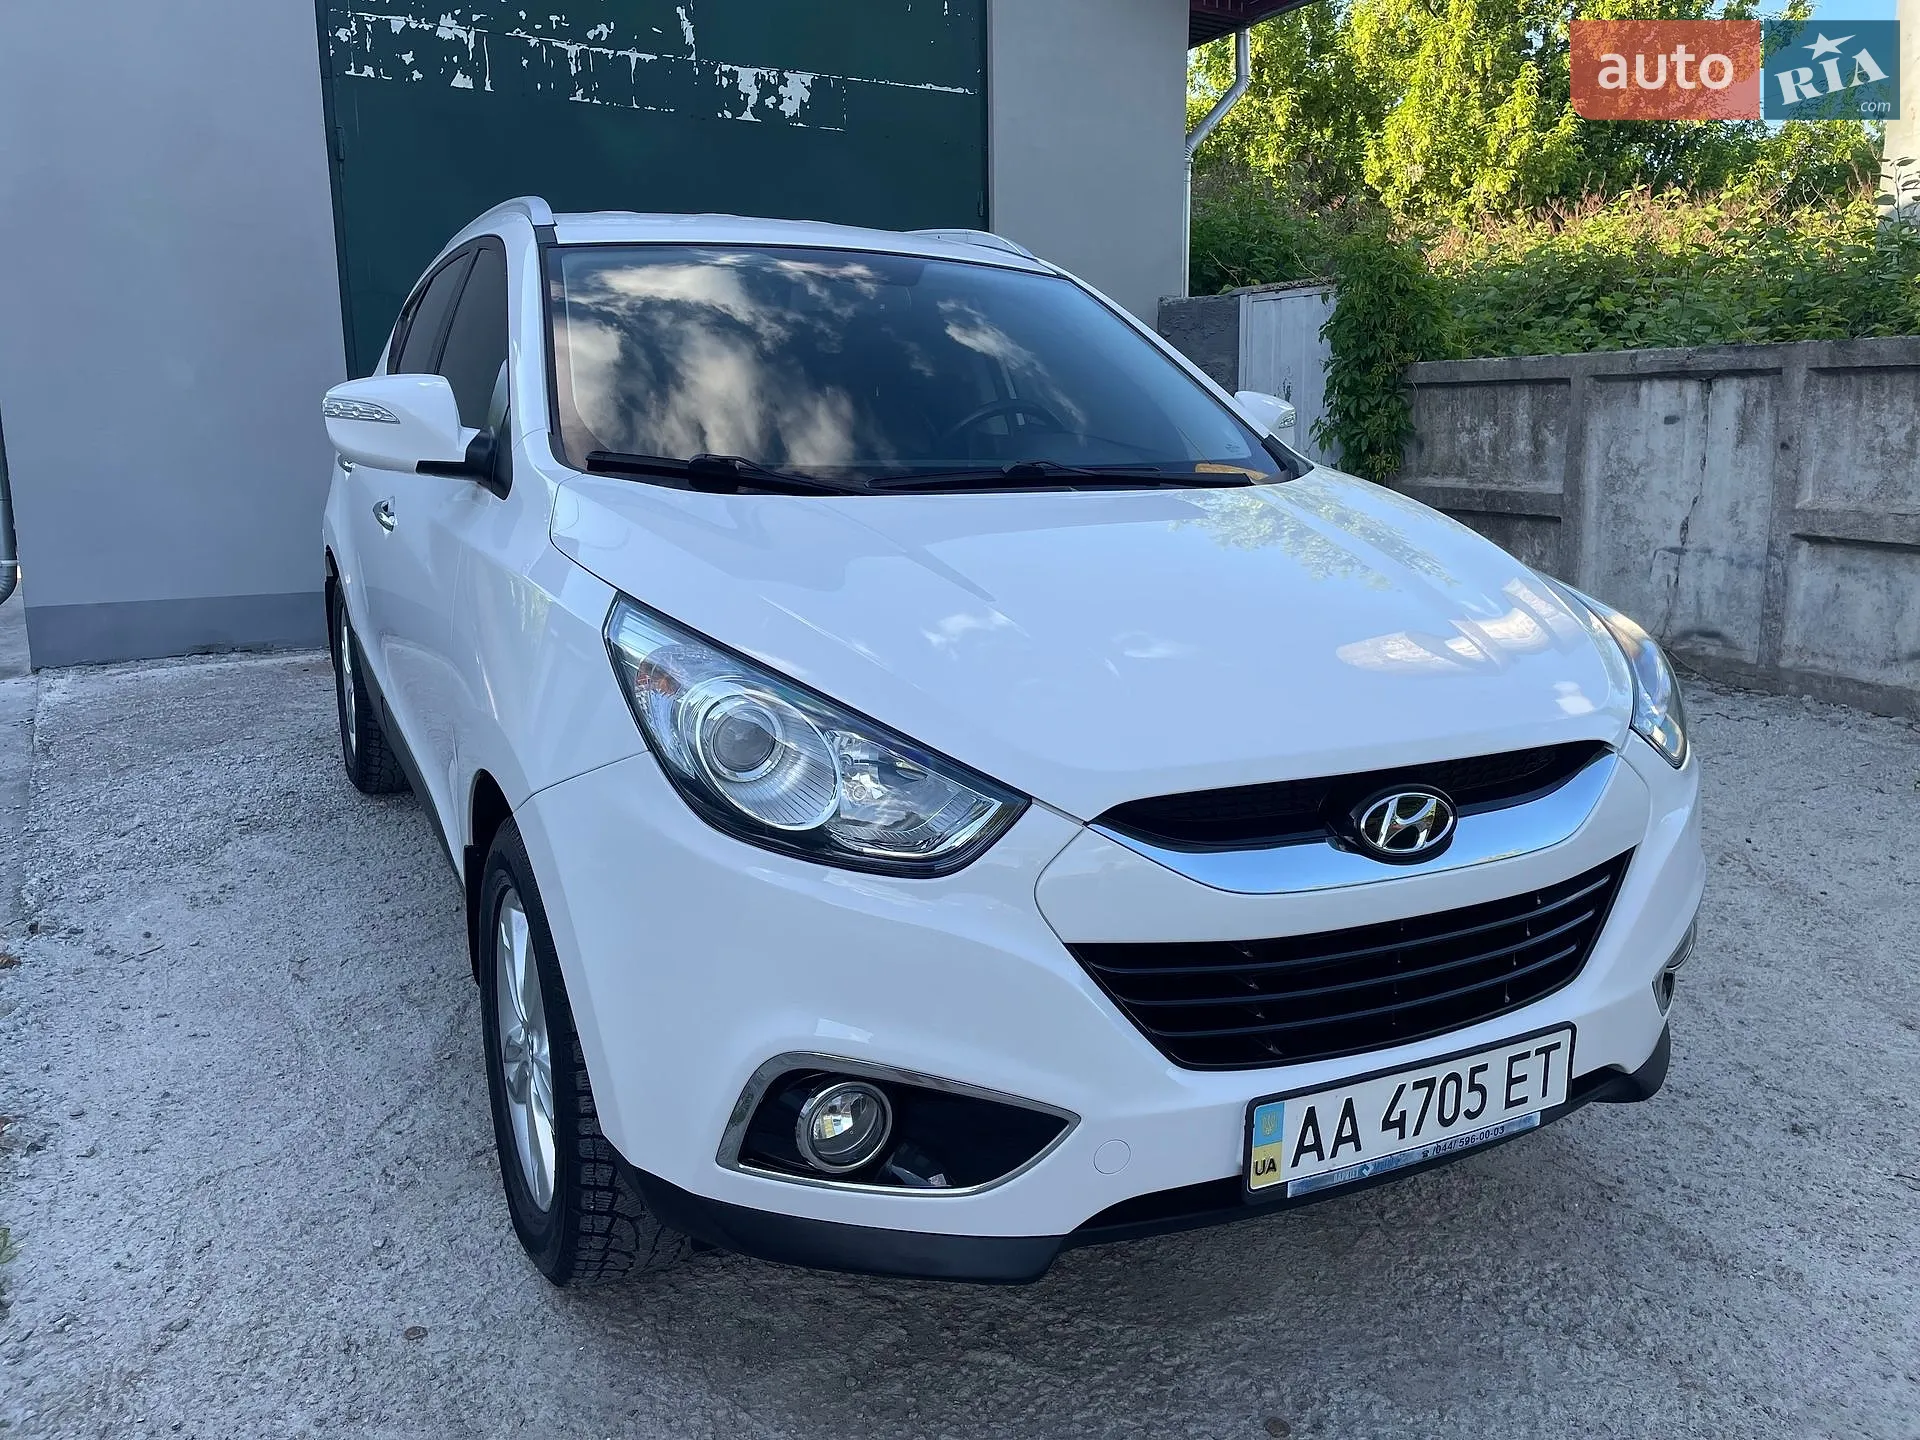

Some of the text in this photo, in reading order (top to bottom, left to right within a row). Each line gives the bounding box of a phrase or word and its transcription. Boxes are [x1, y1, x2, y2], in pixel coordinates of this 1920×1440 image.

[1290, 1041, 1562, 1168] AA 4705 ET
[1254, 1157, 1277, 1176] UA
